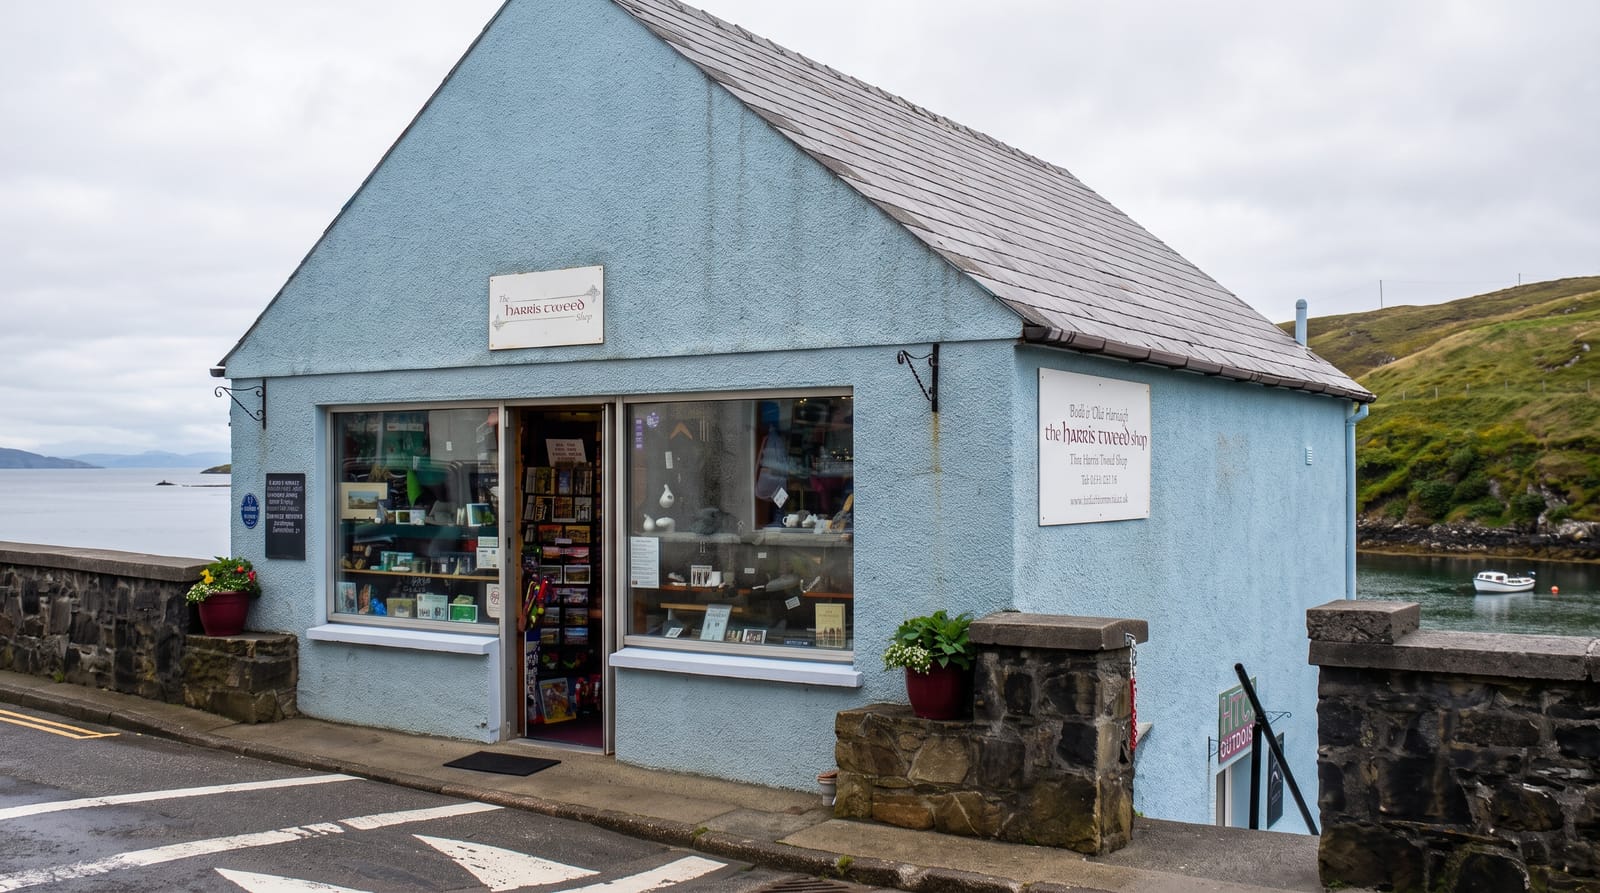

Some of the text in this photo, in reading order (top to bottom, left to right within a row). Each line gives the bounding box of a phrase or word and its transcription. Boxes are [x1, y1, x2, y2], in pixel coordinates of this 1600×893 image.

[499, 294, 510, 303] The
[576, 311, 593, 323] Shop
[1045, 423, 1061, 442] the
[1131, 430, 1148, 451] shop
